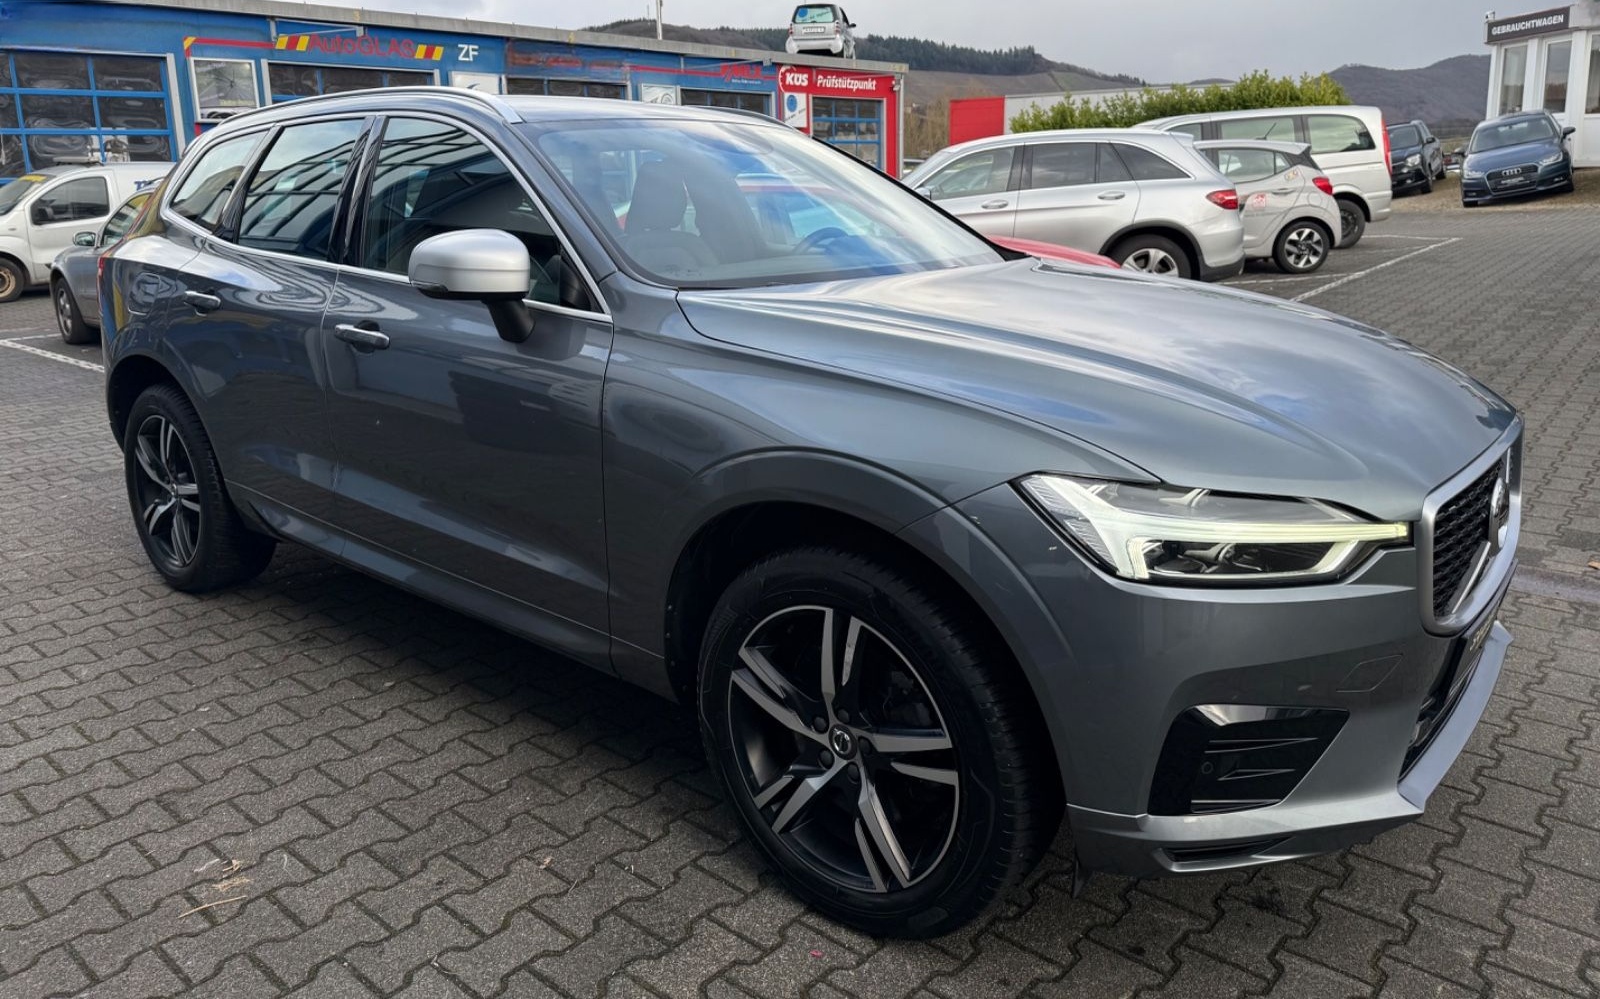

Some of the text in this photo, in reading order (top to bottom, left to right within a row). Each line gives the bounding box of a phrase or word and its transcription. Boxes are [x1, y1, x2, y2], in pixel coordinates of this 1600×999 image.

[1492, 15, 1564, 35] GEBRAUCHTWAGEN
[308, 33, 416, 58] AutoGLAS
[457, 44, 479, 62] ZF
[816, 74, 877, 93] Prüfstützpunkt
